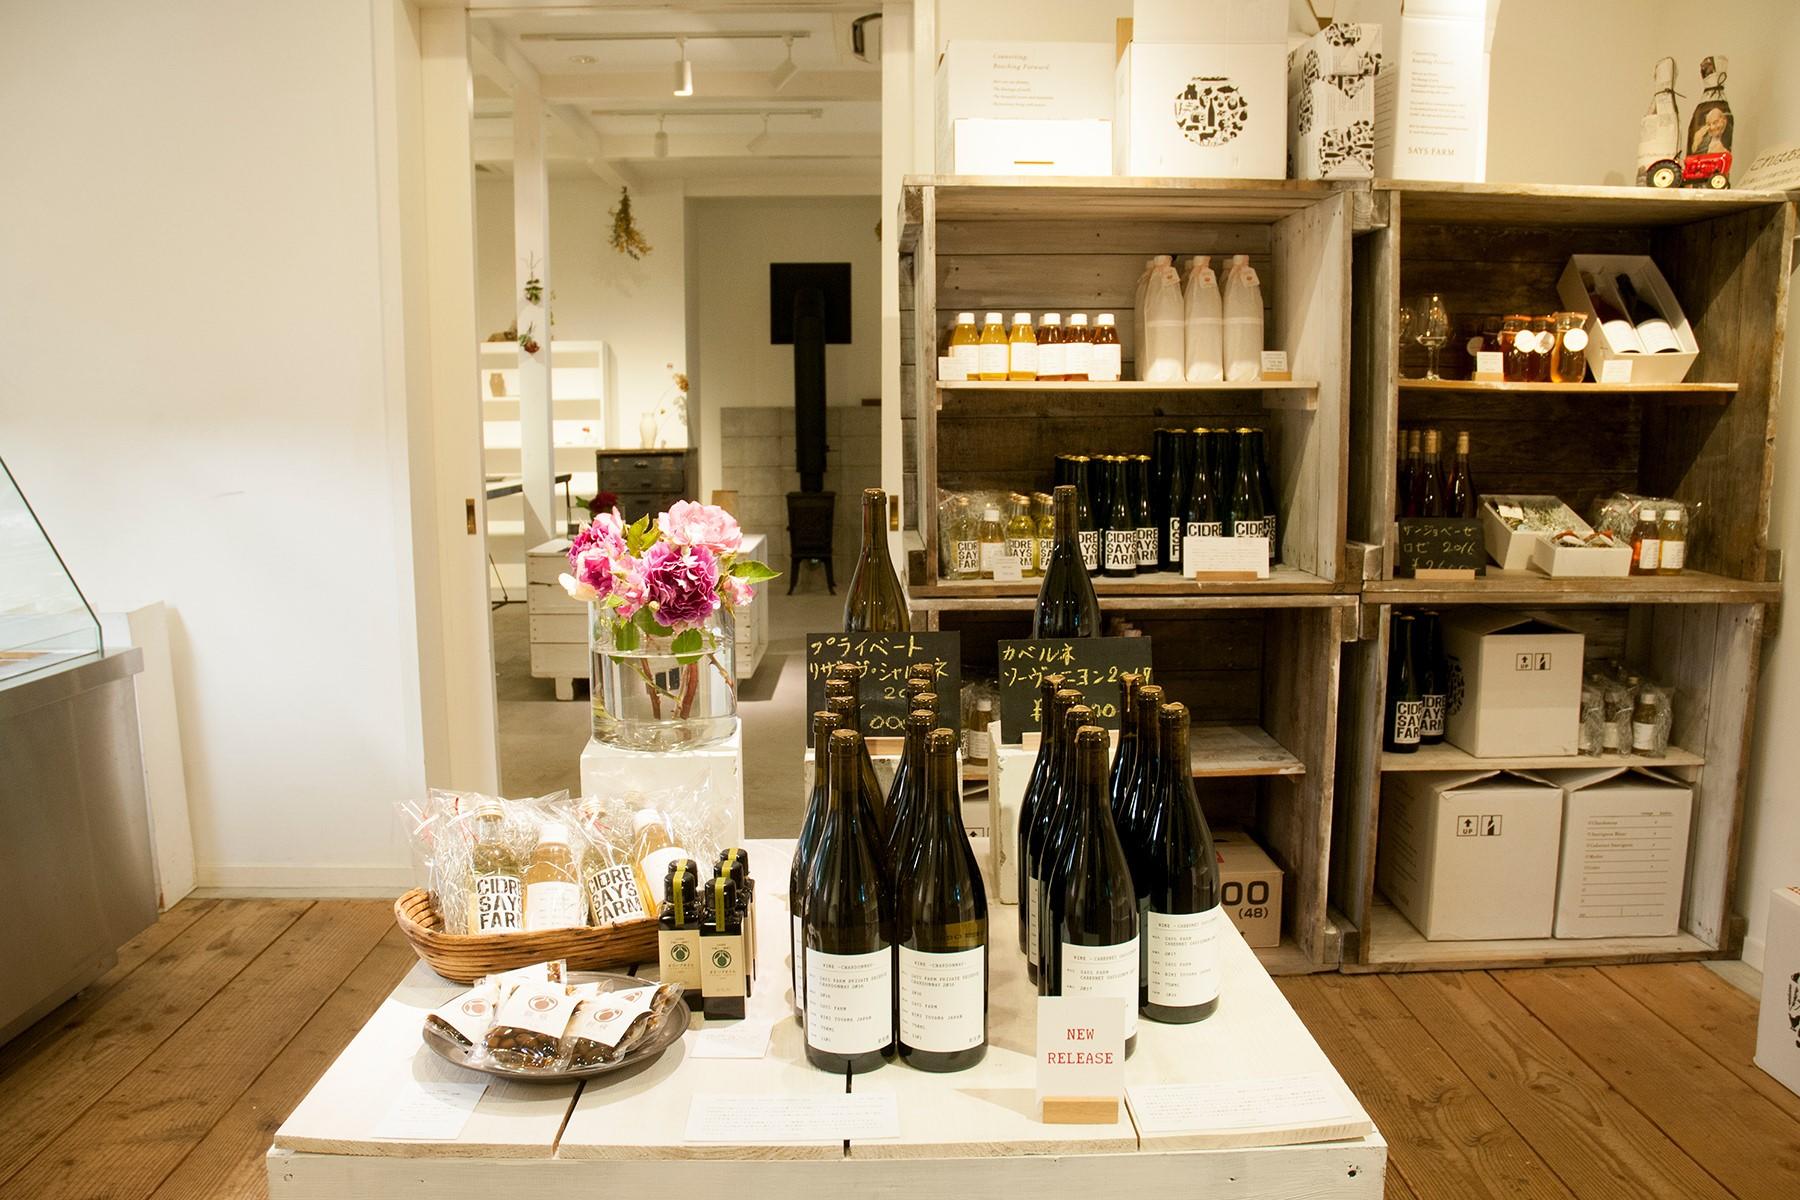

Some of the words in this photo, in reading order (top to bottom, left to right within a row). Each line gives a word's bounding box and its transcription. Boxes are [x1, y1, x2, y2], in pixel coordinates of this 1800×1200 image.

[1407, 146, 1429, 155] SAYS
[1431, 147, 1455, 156] FARM
[1235, 522, 1264, 536] CIDR
[1106, 532, 1137, 543] CIDRE
[957, 542, 978, 551] CIDR
[1106, 543, 1137, 554] SAYS
[1136, 540, 1158, 550] AYS
[958, 551, 978, 560] SAY
[958, 560, 977, 569] FAR
[810, 635, 924, 658] プライベート
[1397, 703, 1423, 715] CIDR
[1422, 708, 1445, 719] AYS
[1397, 715, 1422, 727] SAY
[1396, 727, 1420, 739] FAR
[587, 865, 632, 896] CIDRE
[592, 881, 637, 911] SAYS
[596, 896, 643, 927] FARM
[1238, 907, 1269, 919] (48)
[1067, 1028, 1095, 1040] NEW
[1047, 1052, 1114, 1065] RELEASE
